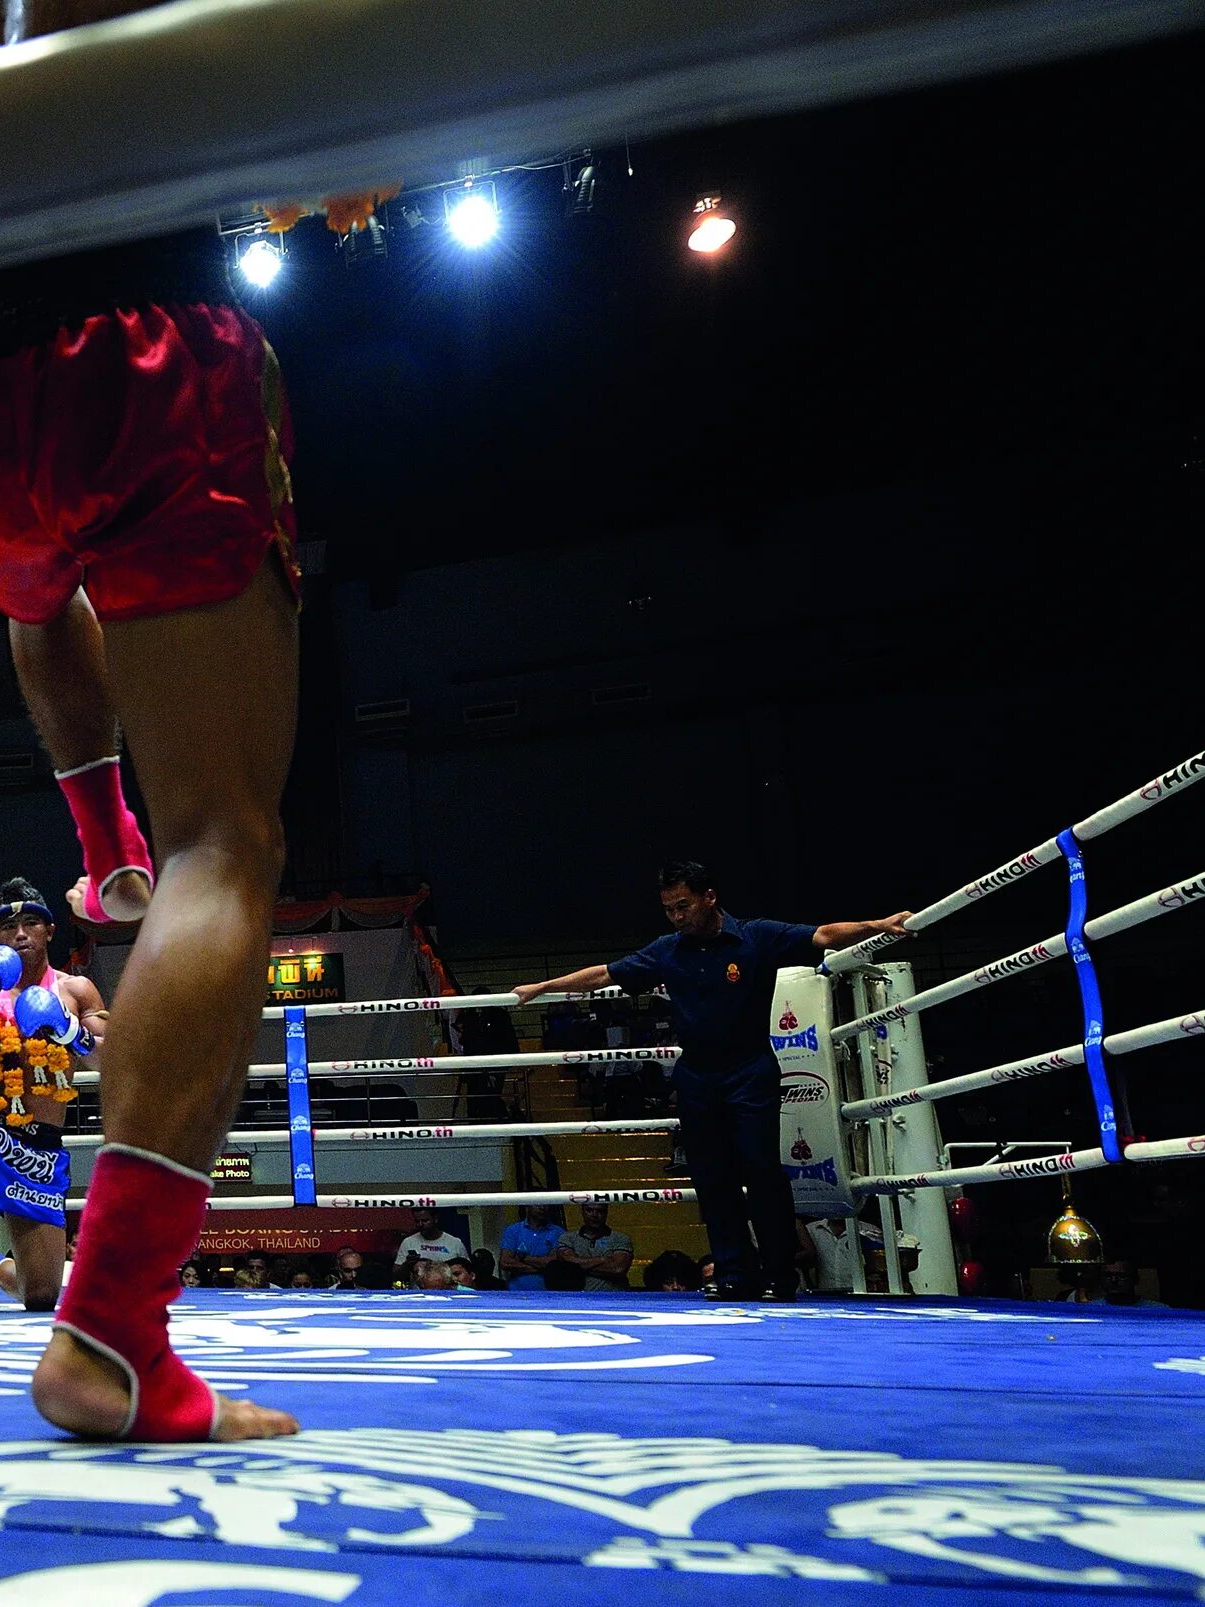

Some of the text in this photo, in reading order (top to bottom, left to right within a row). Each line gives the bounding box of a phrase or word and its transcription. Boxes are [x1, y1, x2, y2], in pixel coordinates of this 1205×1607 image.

[361, 1000, 440, 1012] HINO.th
[770, 1024, 819, 1052] WINS
[588, 1047, 675, 1061] HINO.th
[372, 1126, 453, 1139] HINO.th
[594, 1189, 683, 1202] HINO.th
[354, 1198, 436, 1207] HINO.th
[196, 1237, 321, 1250] ANGKOK, THAILAND
